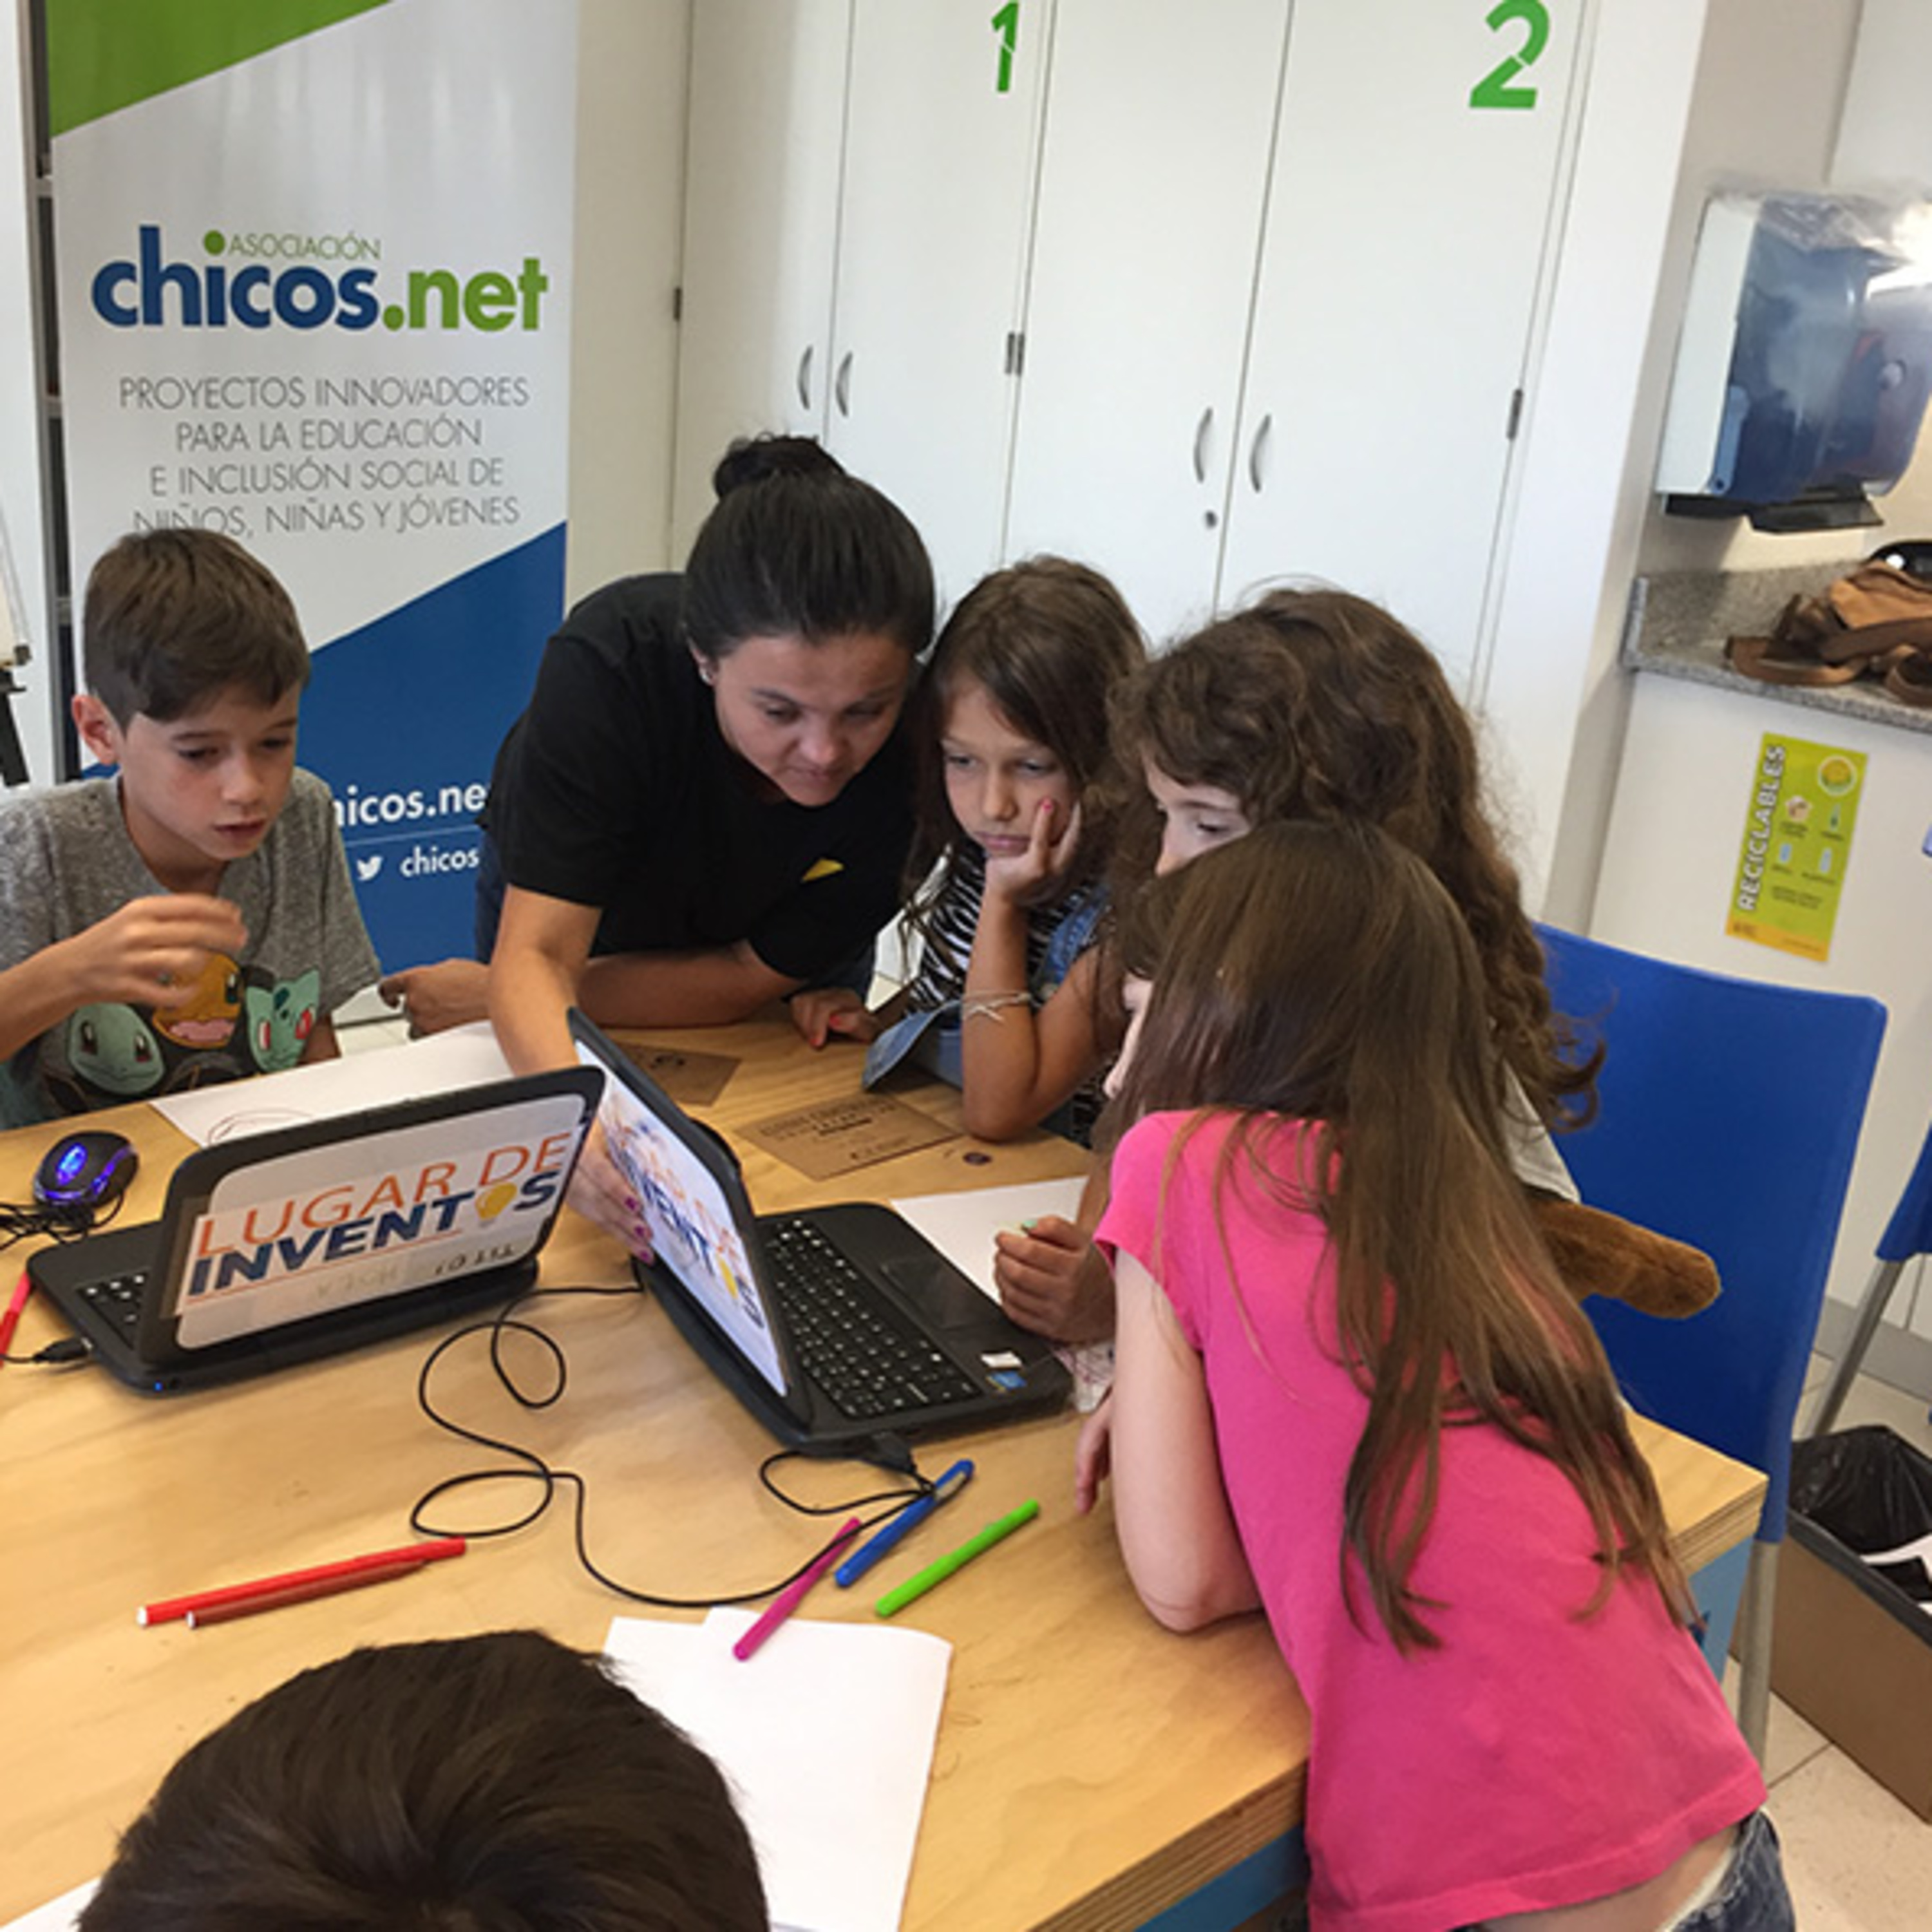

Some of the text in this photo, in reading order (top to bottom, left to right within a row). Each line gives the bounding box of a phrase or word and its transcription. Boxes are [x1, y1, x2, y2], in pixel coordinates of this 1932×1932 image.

[991, 2, 1019, 92] 1
[1469, 0, 1550, 108] 2
[229, 231, 381, 258] ASOCIACIÓN
[92, 225, 547, 330] chicos.net
[120, 375, 529, 410] PROYECTOS INNOVADORES
[176, 413, 481, 451] PARA LA EDUCACIÓN
[151, 455, 504, 496] E INCLUSIÓN SOCIAL DE
[266, 497, 365, 533] NIÑAS
[372, 501, 391, 528] Y
[396, 493, 521, 533] JÓVENES
[1737, 744, 1786, 911] RECICLABLES
[400, 845, 480, 878] chicos
[197, 1132, 572, 1257] LUGAR DE
